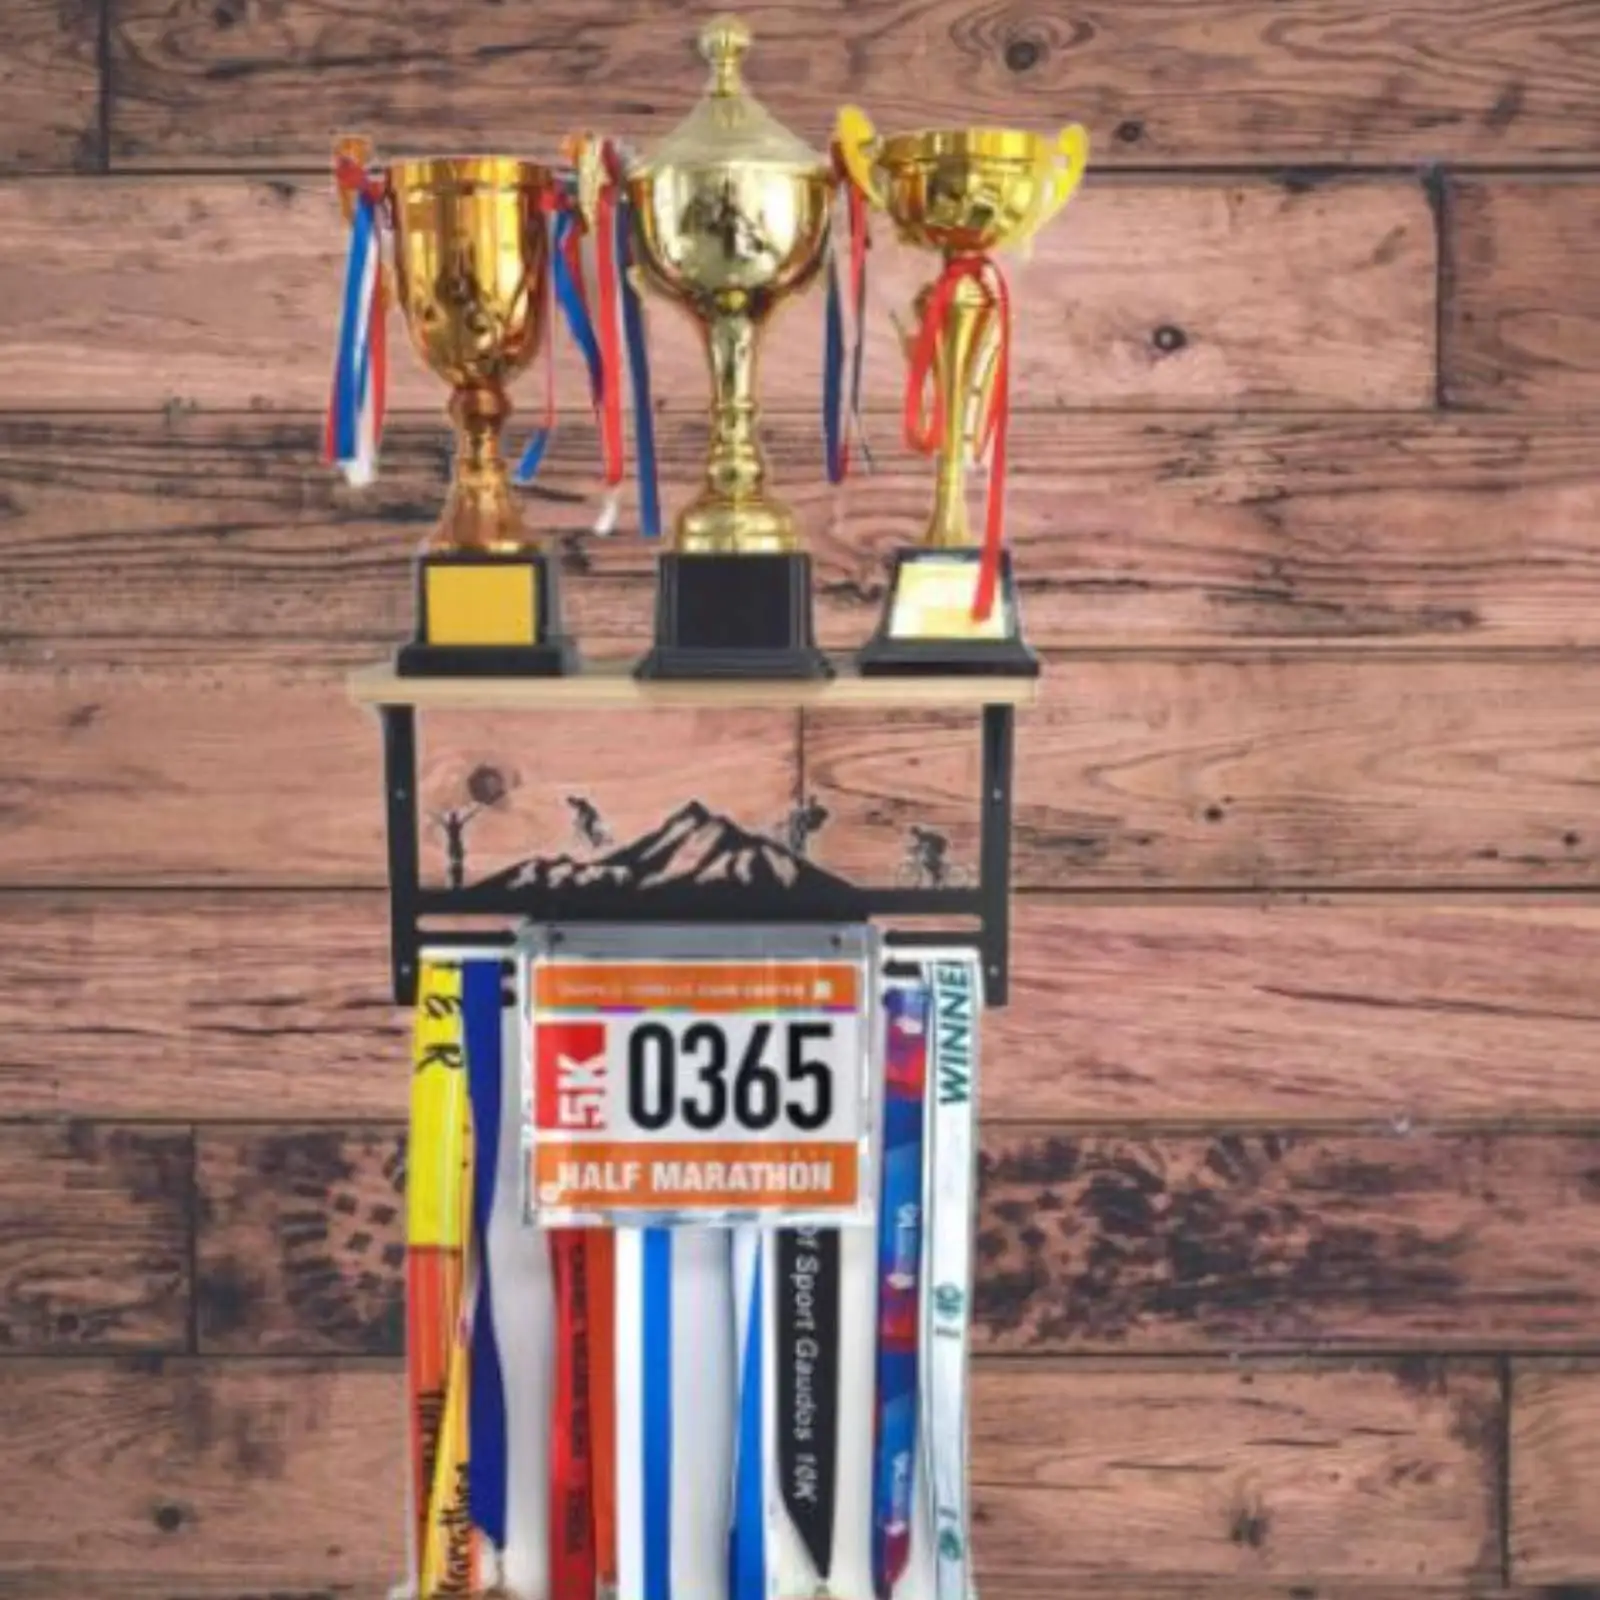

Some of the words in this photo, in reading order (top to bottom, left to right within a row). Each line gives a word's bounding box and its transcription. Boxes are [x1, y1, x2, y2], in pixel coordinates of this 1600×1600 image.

[556, 1052, 605, 1127] 5K
[628, 1021, 834, 1132] 0365
[557, 1160, 641, 1191] HALF
[651, 1160, 834, 1192] MARATHON
[789, 1254, 821, 1331] Sport
